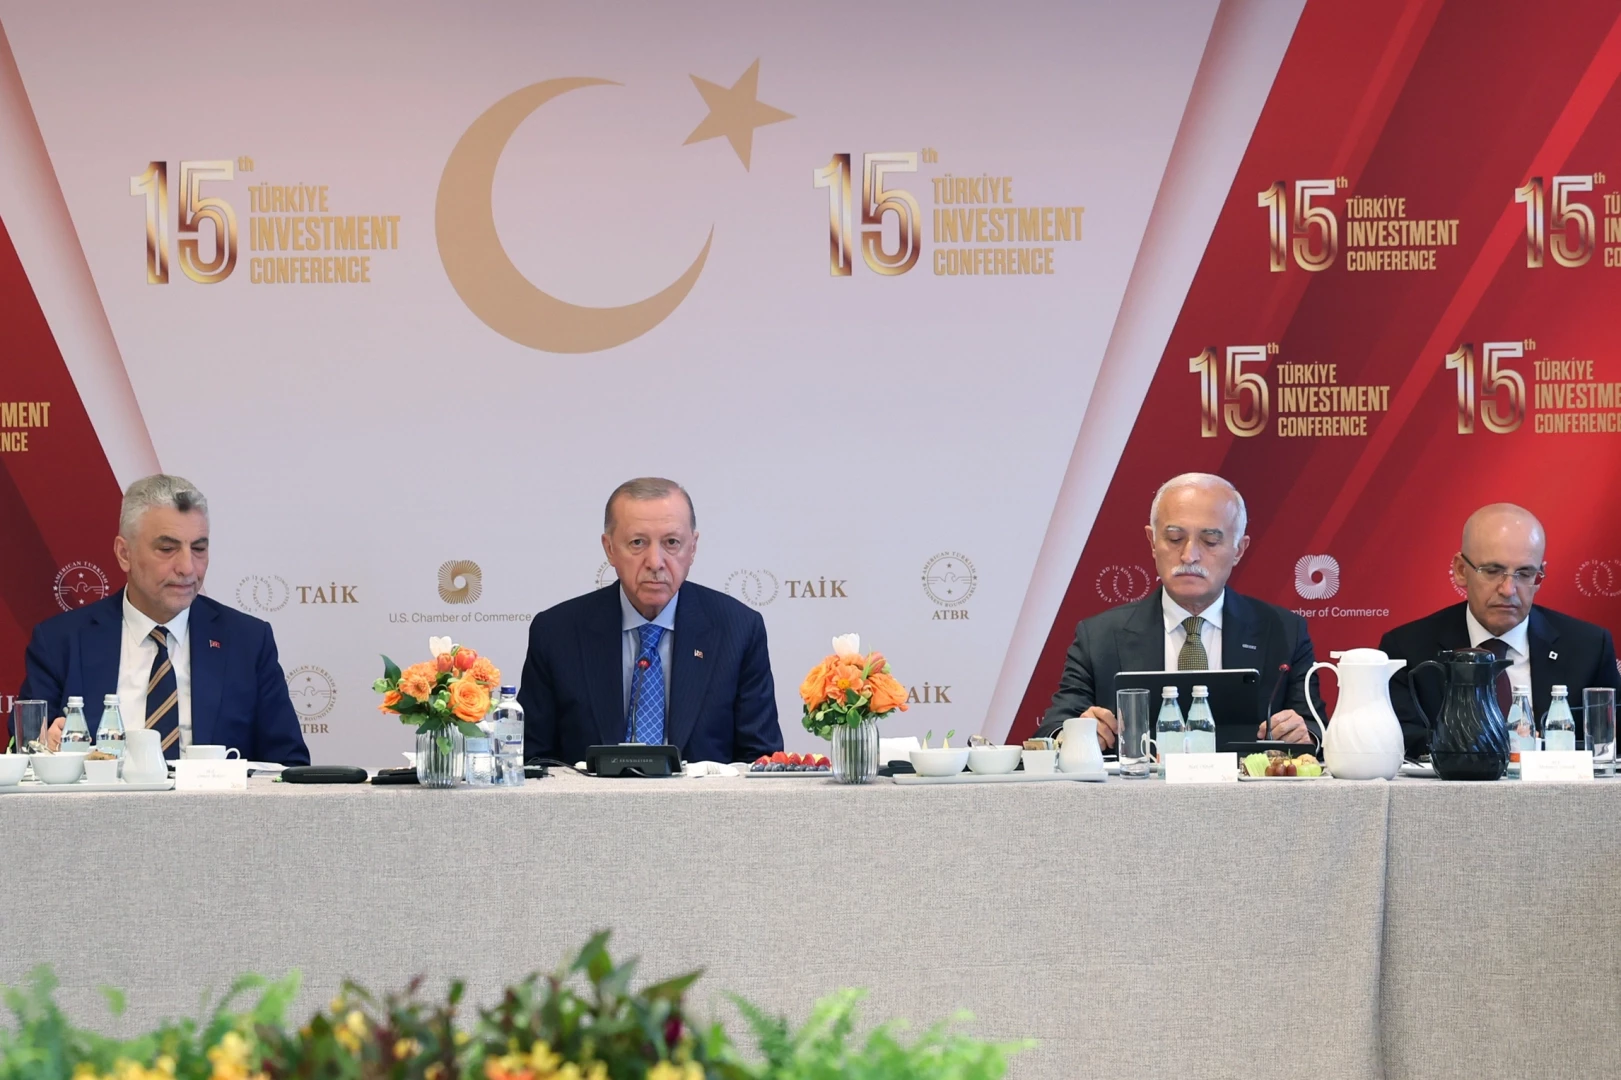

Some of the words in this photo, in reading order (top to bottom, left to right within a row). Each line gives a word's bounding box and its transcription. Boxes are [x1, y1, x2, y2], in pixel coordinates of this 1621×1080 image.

[248, 182, 329, 213] TÜRKİYE
[931, 173, 1013, 204] TÜRKİYE
[1346, 195, 1406, 218] TÜRKİYE
[250, 216, 400, 251] INVESTMENT
[933, 206, 1085, 242] INVESTMENT
[1346, 220, 1459, 247] INVESTMENT
[250, 256, 371, 284] CONFERENCE
[933, 248, 1054, 276] CONFERENCE
[1347, 250, 1437, 271] CONFERENCE
[1276, 361, 1337, 384] TÜRKİYE
[1533, 358, 1594, 381] TÜRKİYE
[1277, 386, 1390, 413] INVESTMENT
[1277, 416, 1368, 437] CONFERENCE
[295, 582, 359, 604] TAİK
[784, 576, 848, 599] TAİK
[389, 612, 409, 623] U.S.
[411, 612, 459, 623] Chamber
[461, 612, 472, 622] of
[474, 611, 532, 622] Commerce
[932, 609, 970, 620] ATBR
[1318, 606, 1329, 617] of
[1331, 606, 1390, 618] Commerce
[904, 682, 952, 704] AİK
[301, 723, 329, 734] TBR
